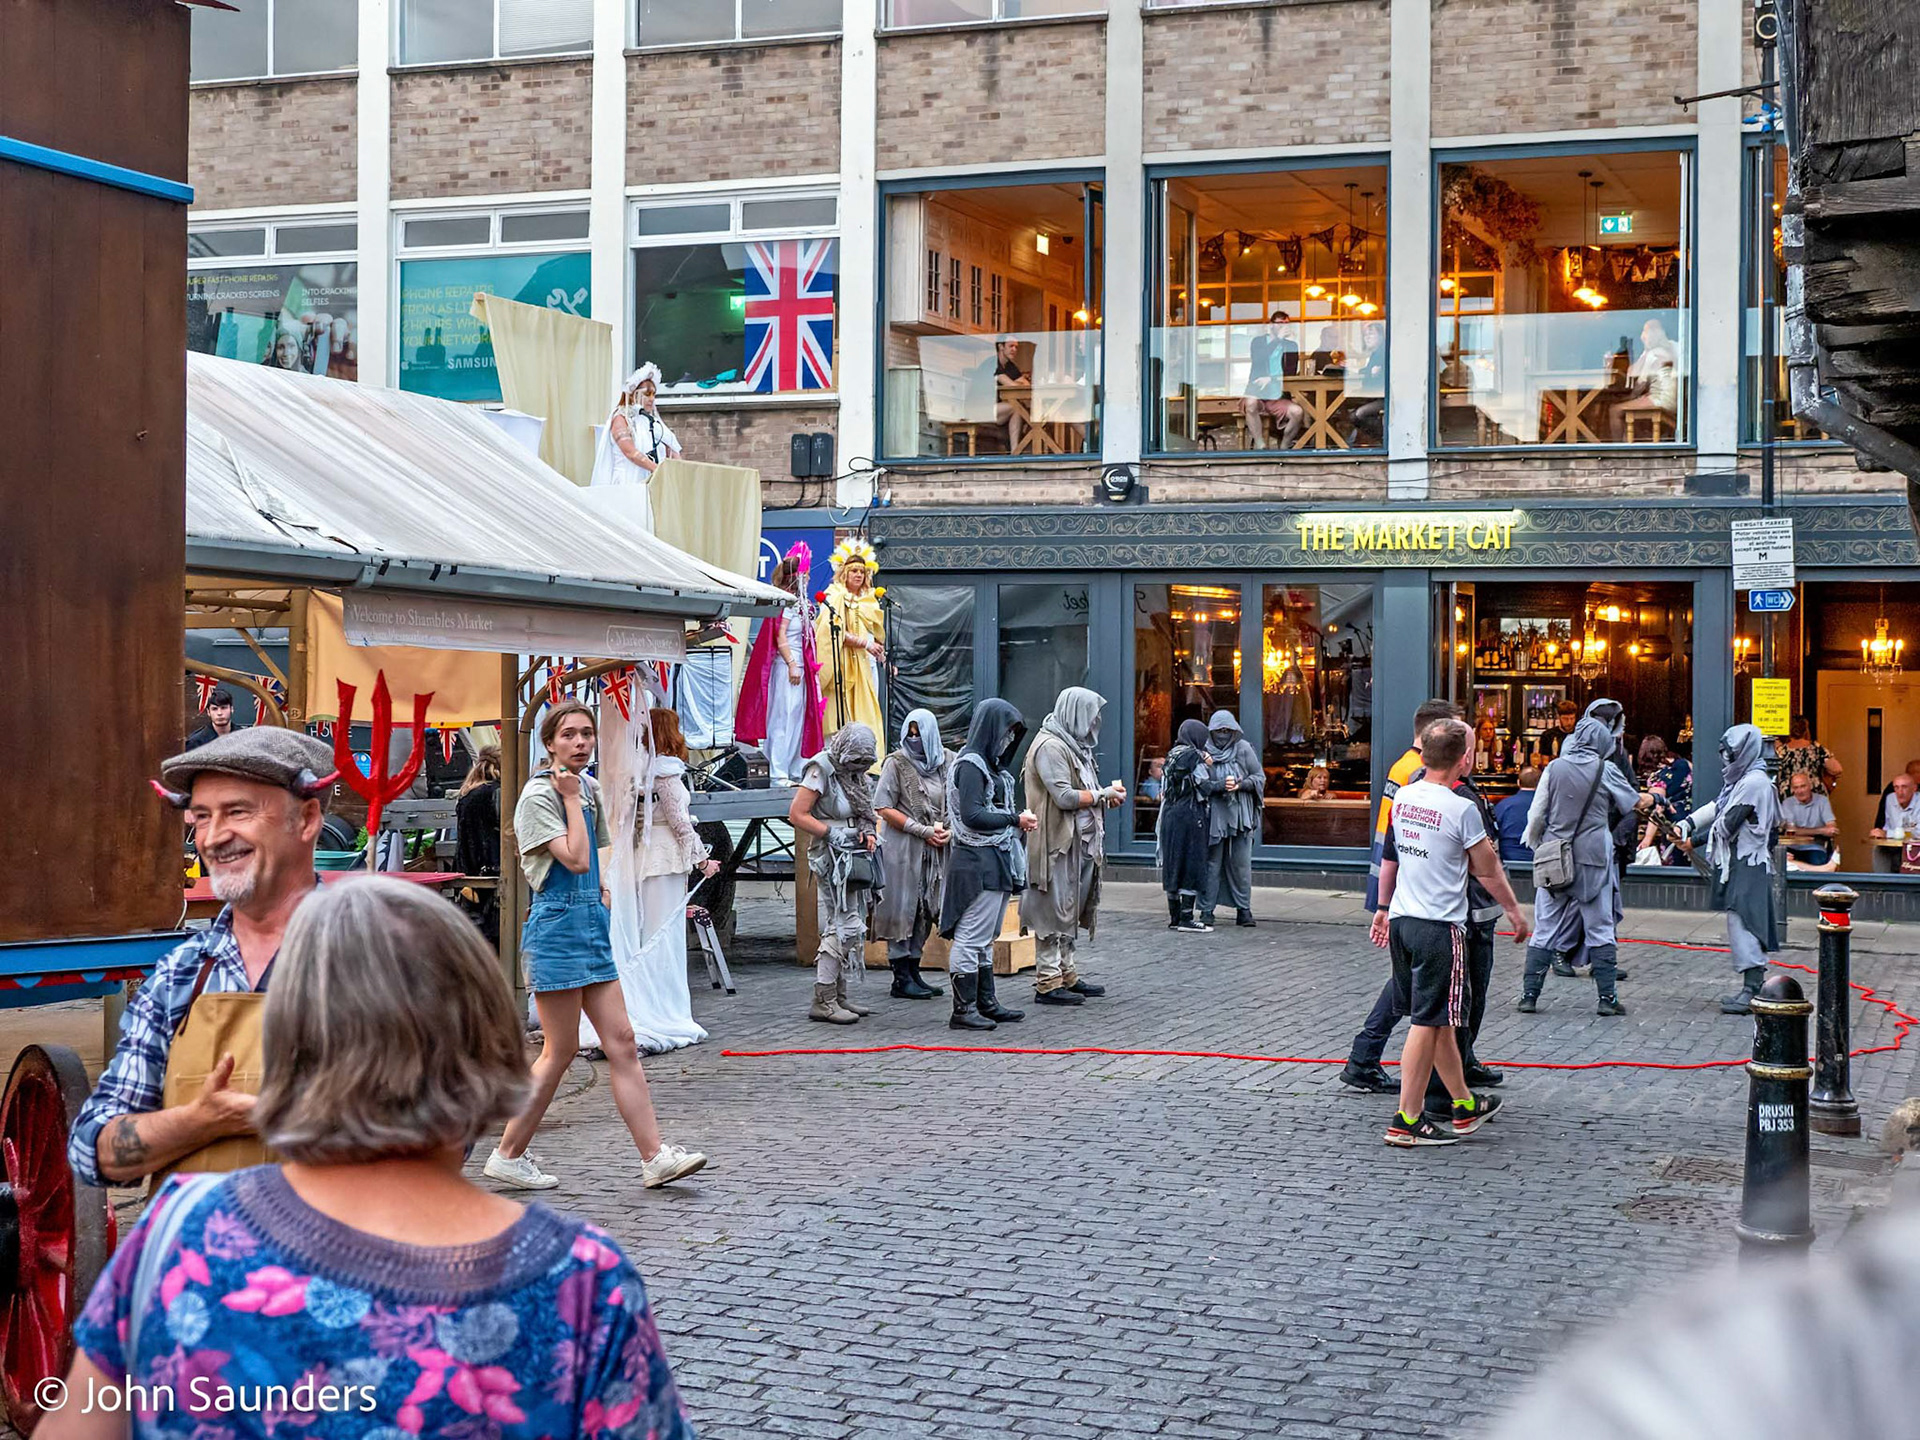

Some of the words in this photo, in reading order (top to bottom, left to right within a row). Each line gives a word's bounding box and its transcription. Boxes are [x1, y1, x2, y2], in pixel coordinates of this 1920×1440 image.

[249, 273, 279, 282] REPAIRS
[217, 291, 248, 300] CRACKED
[249, 289, 280, 298] SCREENS
[302, 288, 320, 297] INTO
[403, 288, 443, 300] PHONE
[301, 297, 330, 307] SELFIES
[403, 303, 434, 315] FROM
[437, 333, 492, 346] NETWOR
[1296, 523, 1345, 551] THE
[1353, 522, 1458, 550] MARKET
[1466, 522, 1517, 550] CAT
[1758, 552, 1768, 561] M
[1767, 595, 1780, 605] WC
[350, 604, 394, 626] Welcome
[396, 613, 406, 625] to
[407, 608, 456, 629] Shambles
[457, 612, 494, 632] Market
[615, 631, 645, 648] Market
[646, 633, 673, 653] Square
[1401, 811, 1437, 825] MARATHON
[1402, 828, 1420, 840] TEAM
[1759, 1104, 1794, 1117] DRUSKI
[1759, 1118, 1776, 1131] PBJ
[1777, 1118, 1794, 1131] 353
